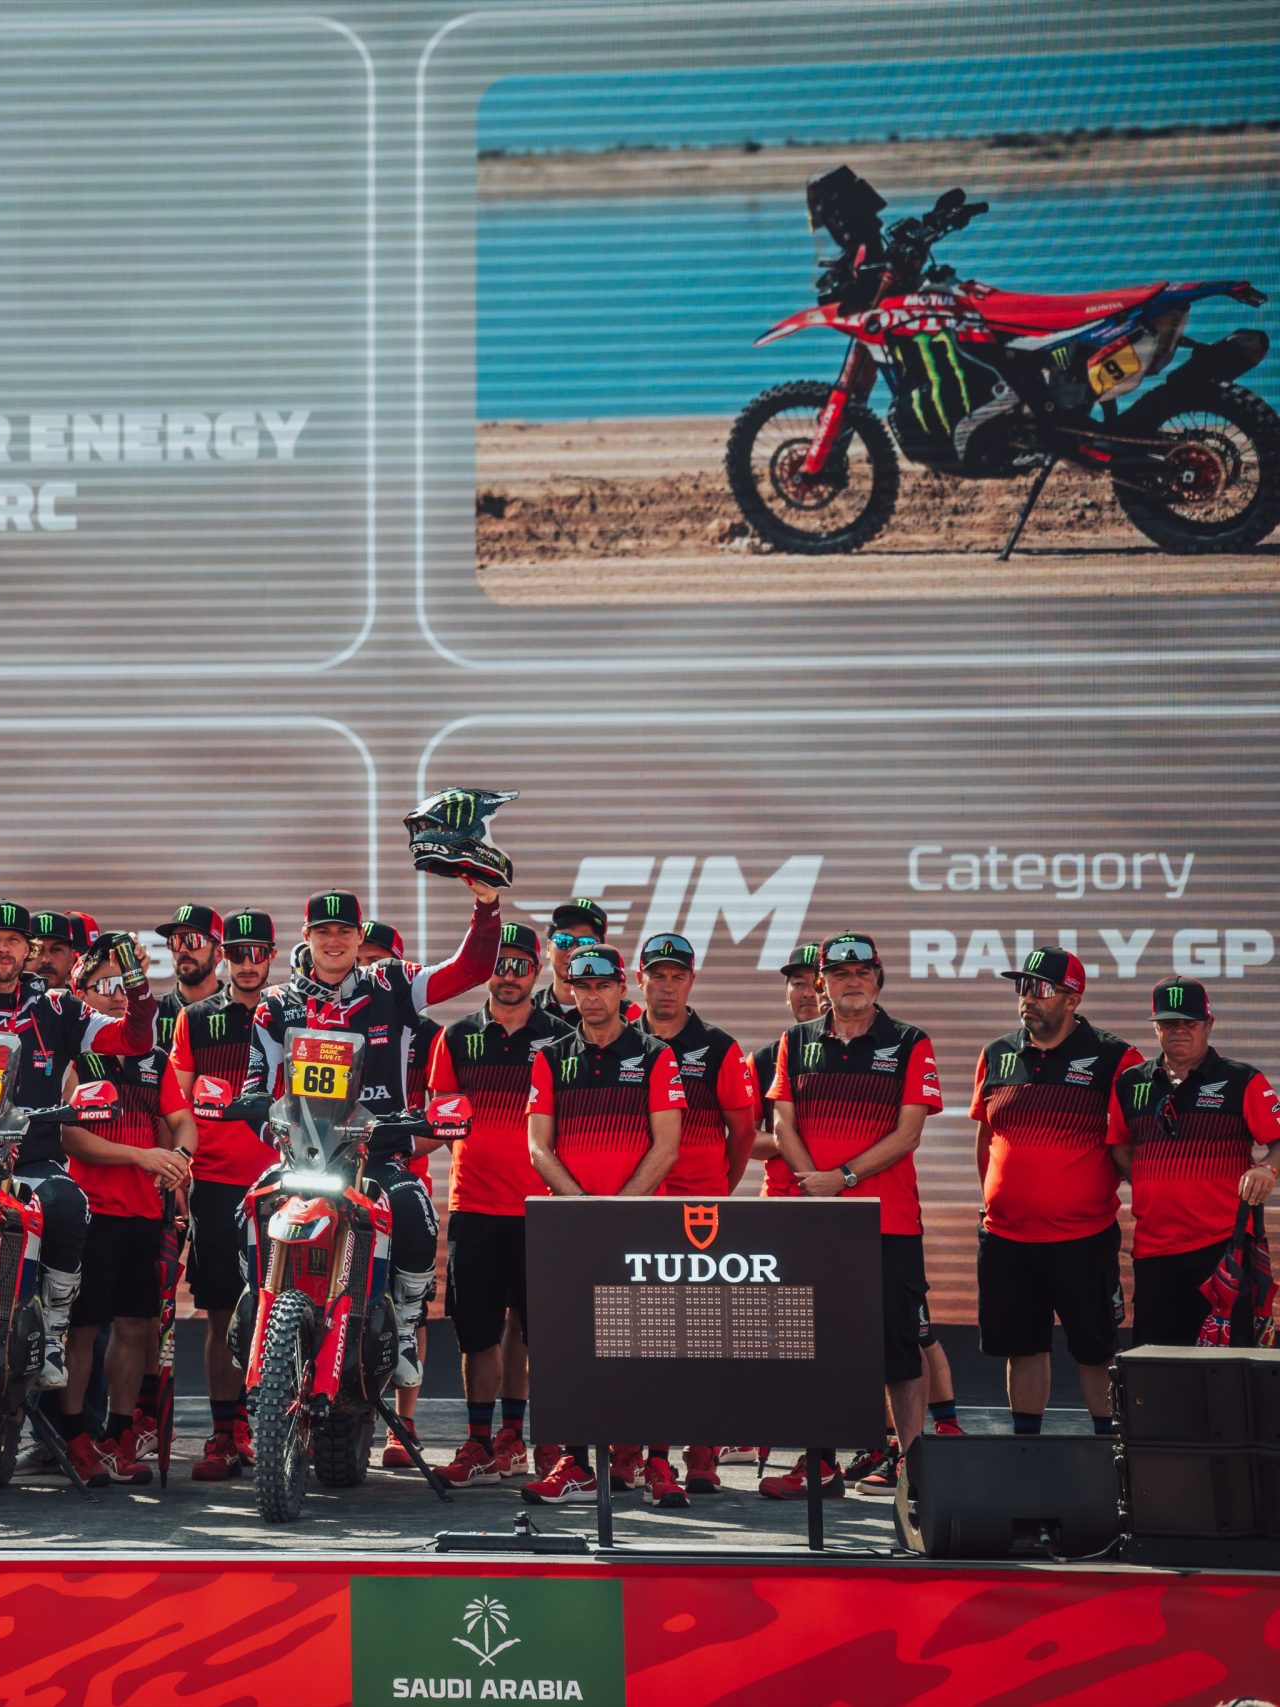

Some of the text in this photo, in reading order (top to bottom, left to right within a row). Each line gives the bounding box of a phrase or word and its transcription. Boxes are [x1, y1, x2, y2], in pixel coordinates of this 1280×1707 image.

[1103, 359, 1126, 382] 9
[29, 410, 312, 462] ENERGY
[908, 845, 1195, 899] Category
[542, 855, 824, 970] FIM
[1173, 929, 1275, 978] GP
[320, 1043, 346, 1051] DREAM.
[370, 1037, 389, 1045] MOTUL
[303, 1065, 335, 1094] 68
[1068, 1067, 1094, 1076] HONDA
[80, 1111, 111, 1119] MOTUL
[194, 1107, 220, 1117] MOTUL
[436, 1127, 466, 1136] MOTUL
[624, 1253, 781, 1283] TUDOR
[332, 1313, 348, 1381] HONDA
[393, 1678, 583, 1700] SAUDI ARABIA
